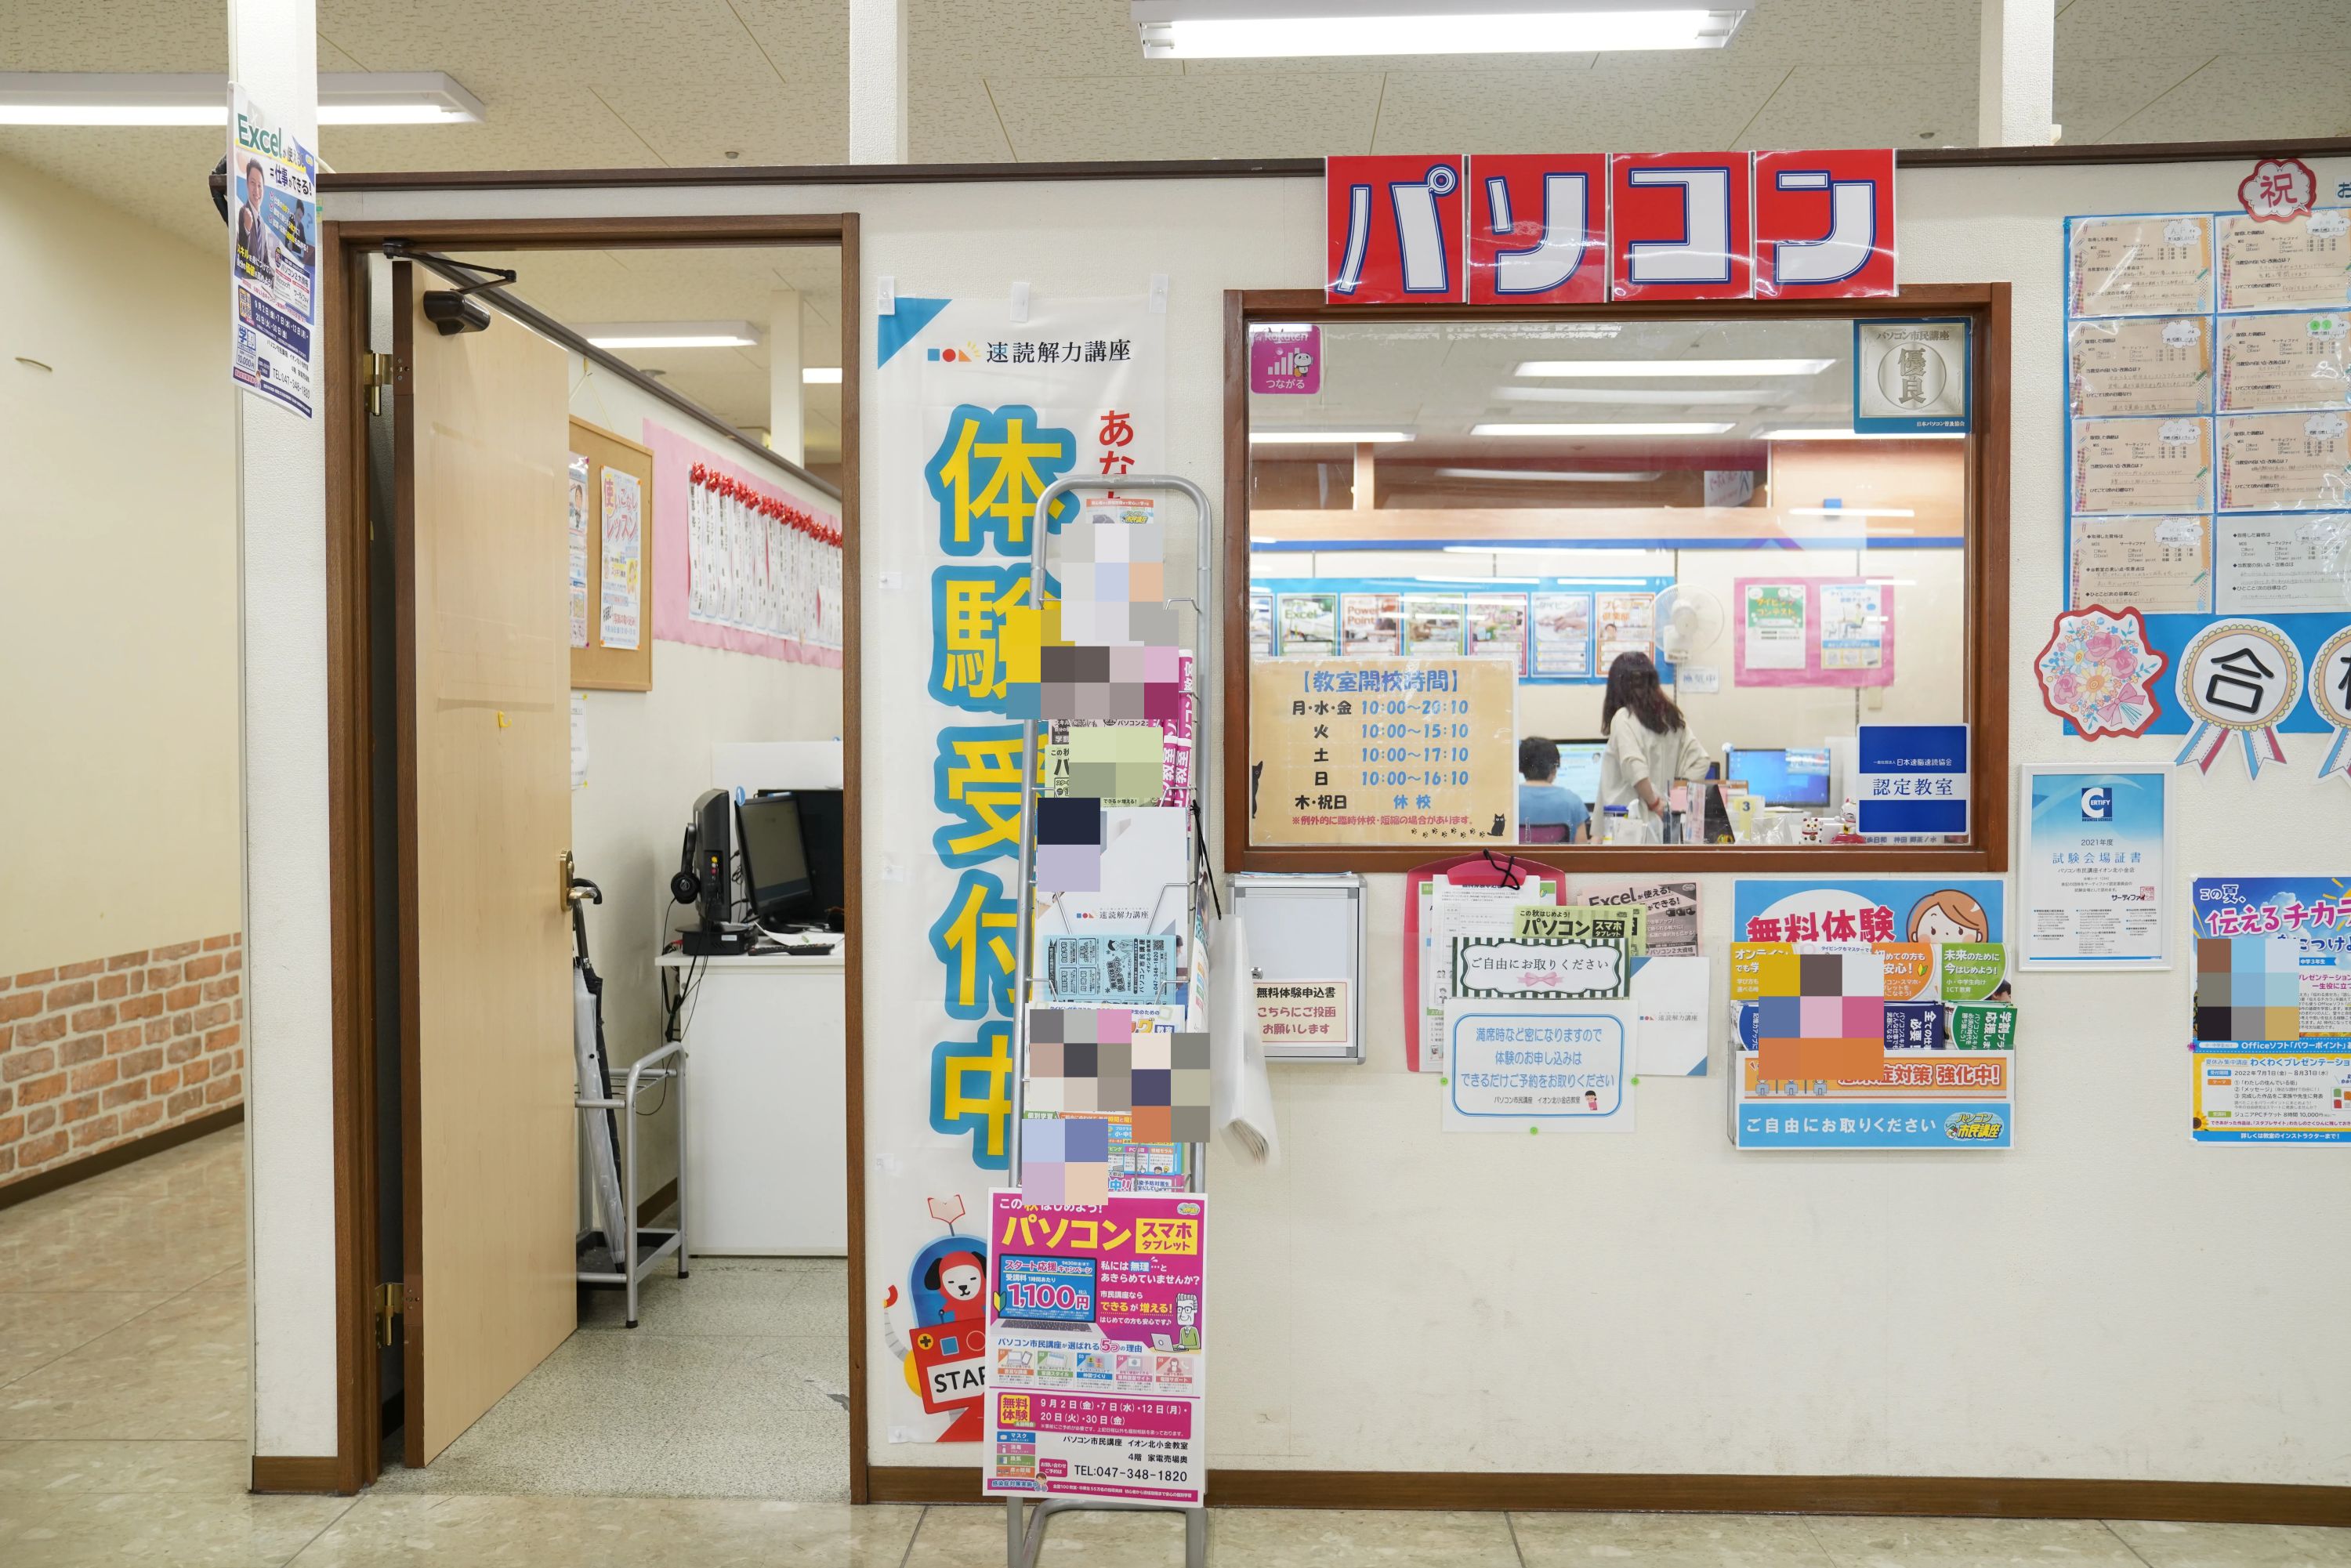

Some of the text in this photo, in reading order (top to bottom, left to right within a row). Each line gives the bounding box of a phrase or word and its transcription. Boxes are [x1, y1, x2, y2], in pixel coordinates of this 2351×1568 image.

[2260, 173, 2297, 208] 祝
[1336, 163, 1876, 296] パソコン
[1876, 331, 1950, 341] パソコン市民講座
[986, 339, 1132, 364] 速読解力講座
[1897, 348, 1926, 404] 優良
[1266, 379, 1305, 389] つながる
[1304, 670, 1458, 693] 【教室開校時間】
[2206, 648, 2274, 713] 合
[1292, 701, 1352, 715] 月・水・金
[1314, 724, 1329, 739] 火
[1313, 748, 1329, 762] 土
[1315, 772, 1328, 786] 日
[1873, 778, 1953, 796] 認定教室
[1295, 795, 1347, 809] 木・祝日
[2052, 853, 2142, 864] 試験会場証書
[2200, 884, 2247, 904] この夏、
[1099, 909, 1149, 920] 速読解力講座
[1520, 909, 1570, 918] この秋はじめよう!
[1522, 918, 1622, 936] パソコン スマホ
[1746, 906, 1896, 942] 無料体験
[1944, 950, 2000, 961] 未来のために
[1472, 958, 1609, 971] ご自由にお取りください
[1944, 964, 1998, 975] 今はじめよう!
[1256, 987, 1336, 998] 無料体験申込書
[1258, 1006, 1336, 1018] こちらにご投函
[1262, 1023, 1330, 1034] お願いします
[1476, 1028, 1602, 1042] 満席時など密になりますので
[1495, 1051, 1582, 1065] 体験のお申し込みは
[1461, 1074, 1615, 1088] できるだけご予約をお取りください
[1936, 1064, 2000, 1085] 強化中!
[1745, 1113, 1993, 1134] ご自由にお取りください パソコン
[1958, 1124, 2001, 1139] 市民講座
[1002, 1214, 1192, 1251] パソコン スマホ
[1142, 1240, 1190, 1251] タブレット
[1005, 1260, 1057, 1272] スタート応援
[1101, 1273, 1200, 1285] あきらめていませんか?
[1007, 1283, 1090, 1310] 1,100円
[1100, 1302, 1172, 1313] できるが増える!
[998, 1338, 1143, 1353] パソコン市民講座が選ばれる5つの理由
[1003, 1398, 1028, 1409] 無料
[1002, 1410, 1029, 1421] 体験
[1063, 1436, 1188, 1450] パソコン市民講座 イオン北小金教室
[1147, 1454, 1188, 1464] 家電売場奥
[1074, 1465, 1187, 1482] TEL:047-348-1820
